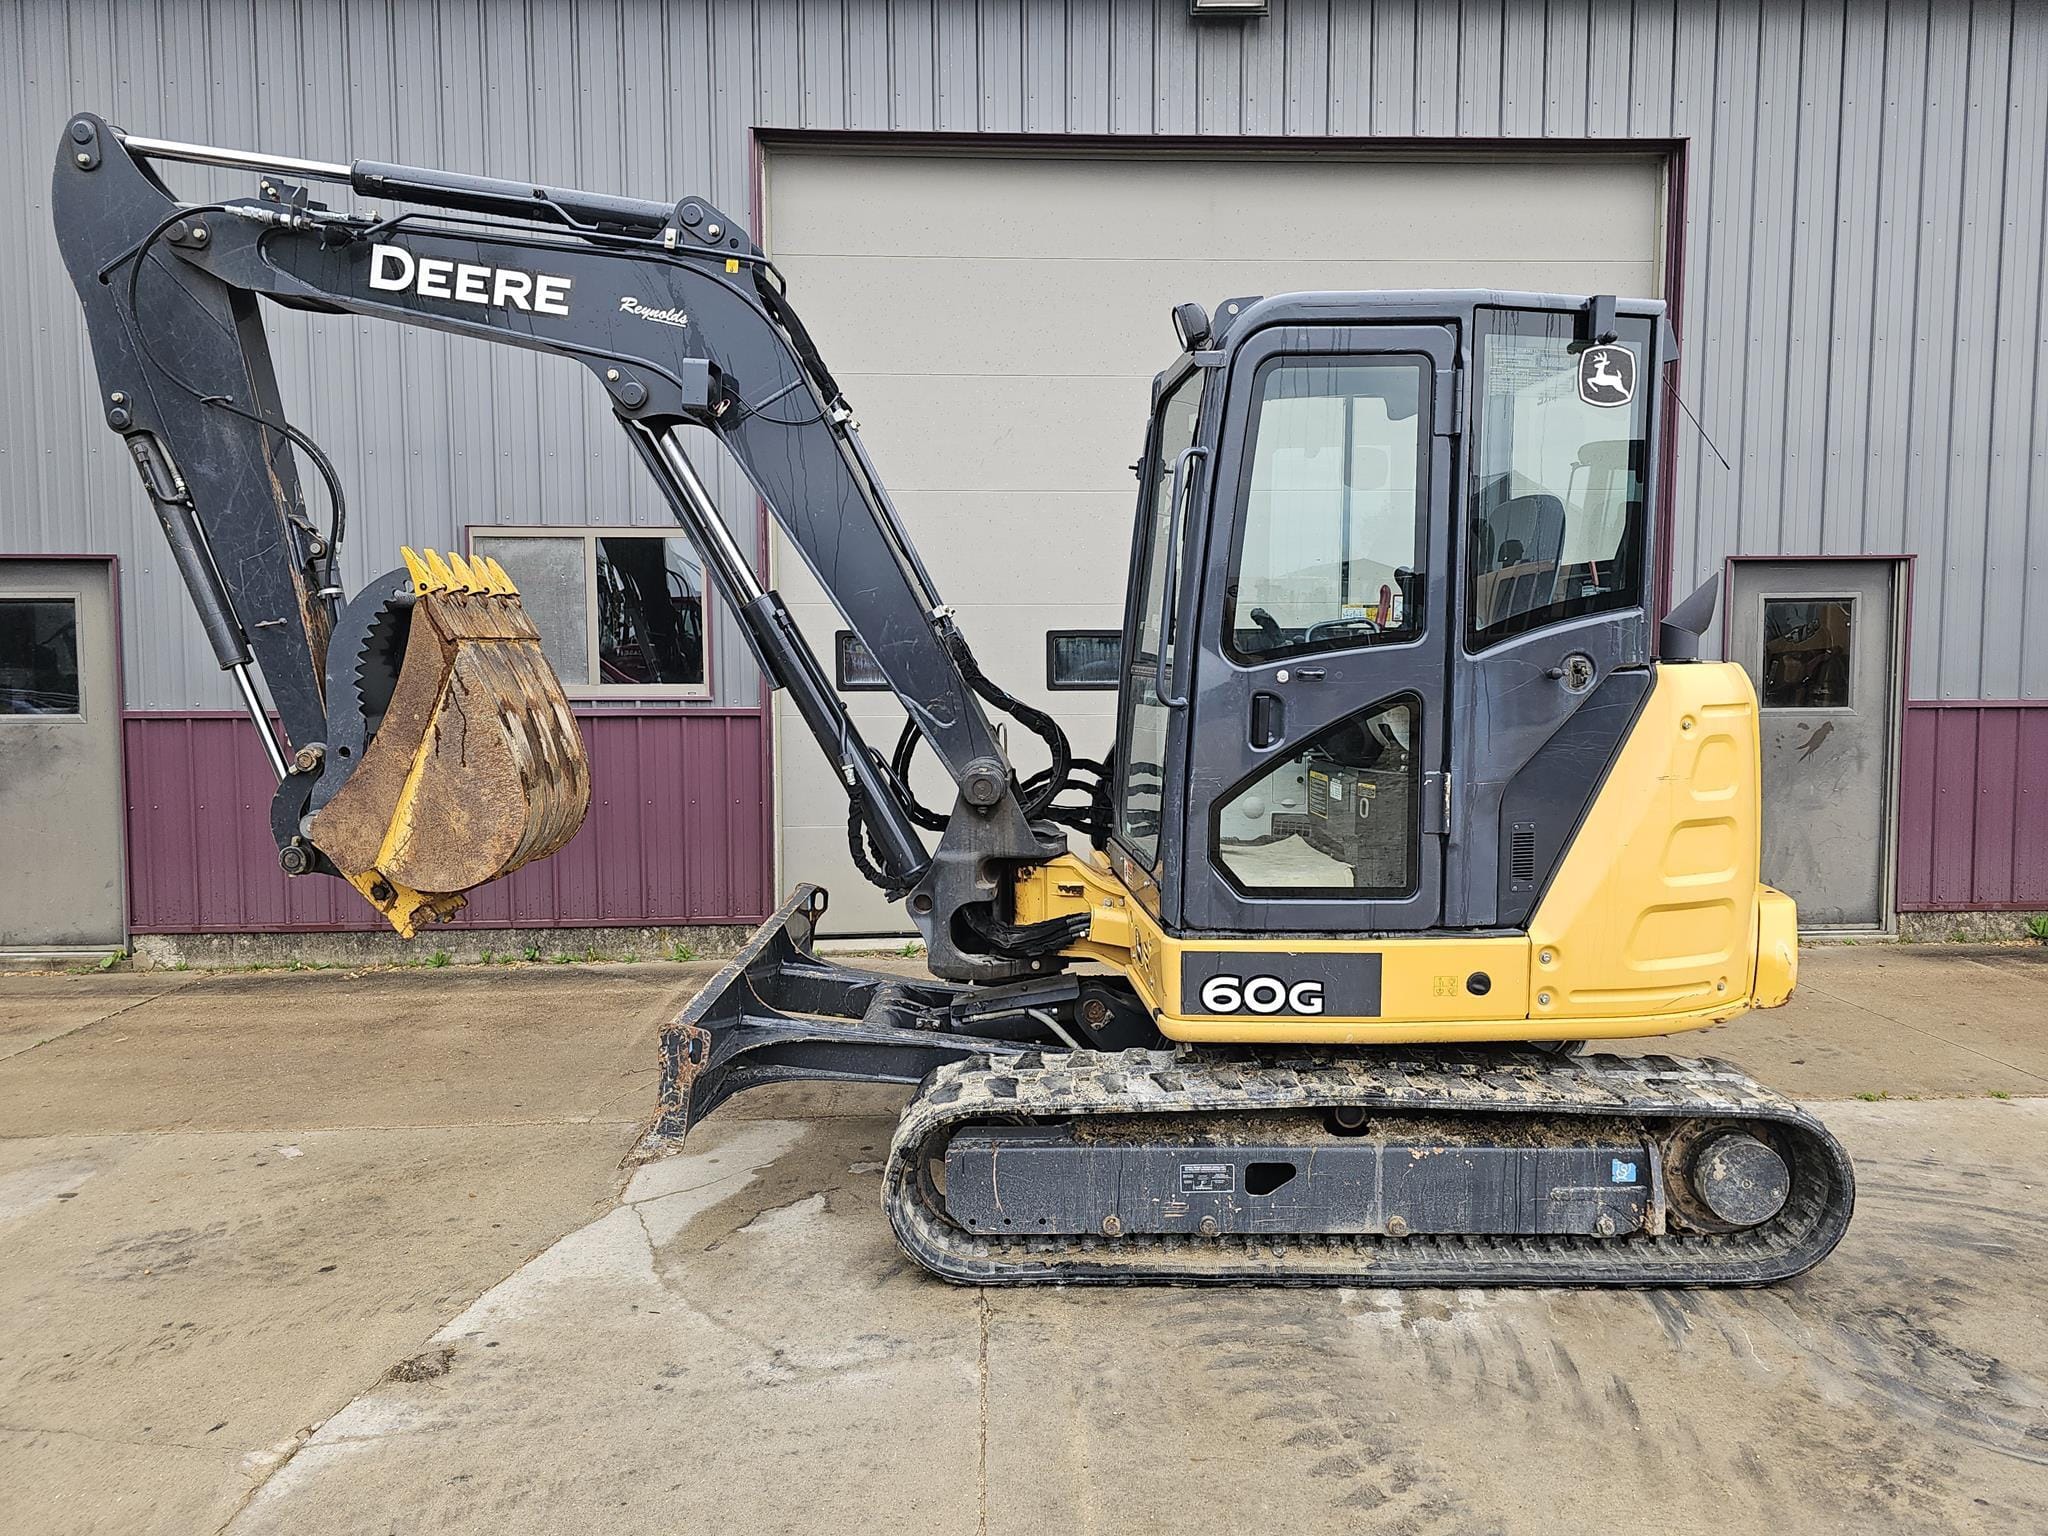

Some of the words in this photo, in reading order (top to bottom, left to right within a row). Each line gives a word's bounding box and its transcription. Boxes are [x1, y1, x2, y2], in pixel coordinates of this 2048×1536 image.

[369, 243, 572, 316] DEERE
[619, 296, 688, 325] Reynolds
[1201, 976, 1324, 1014] 60G
